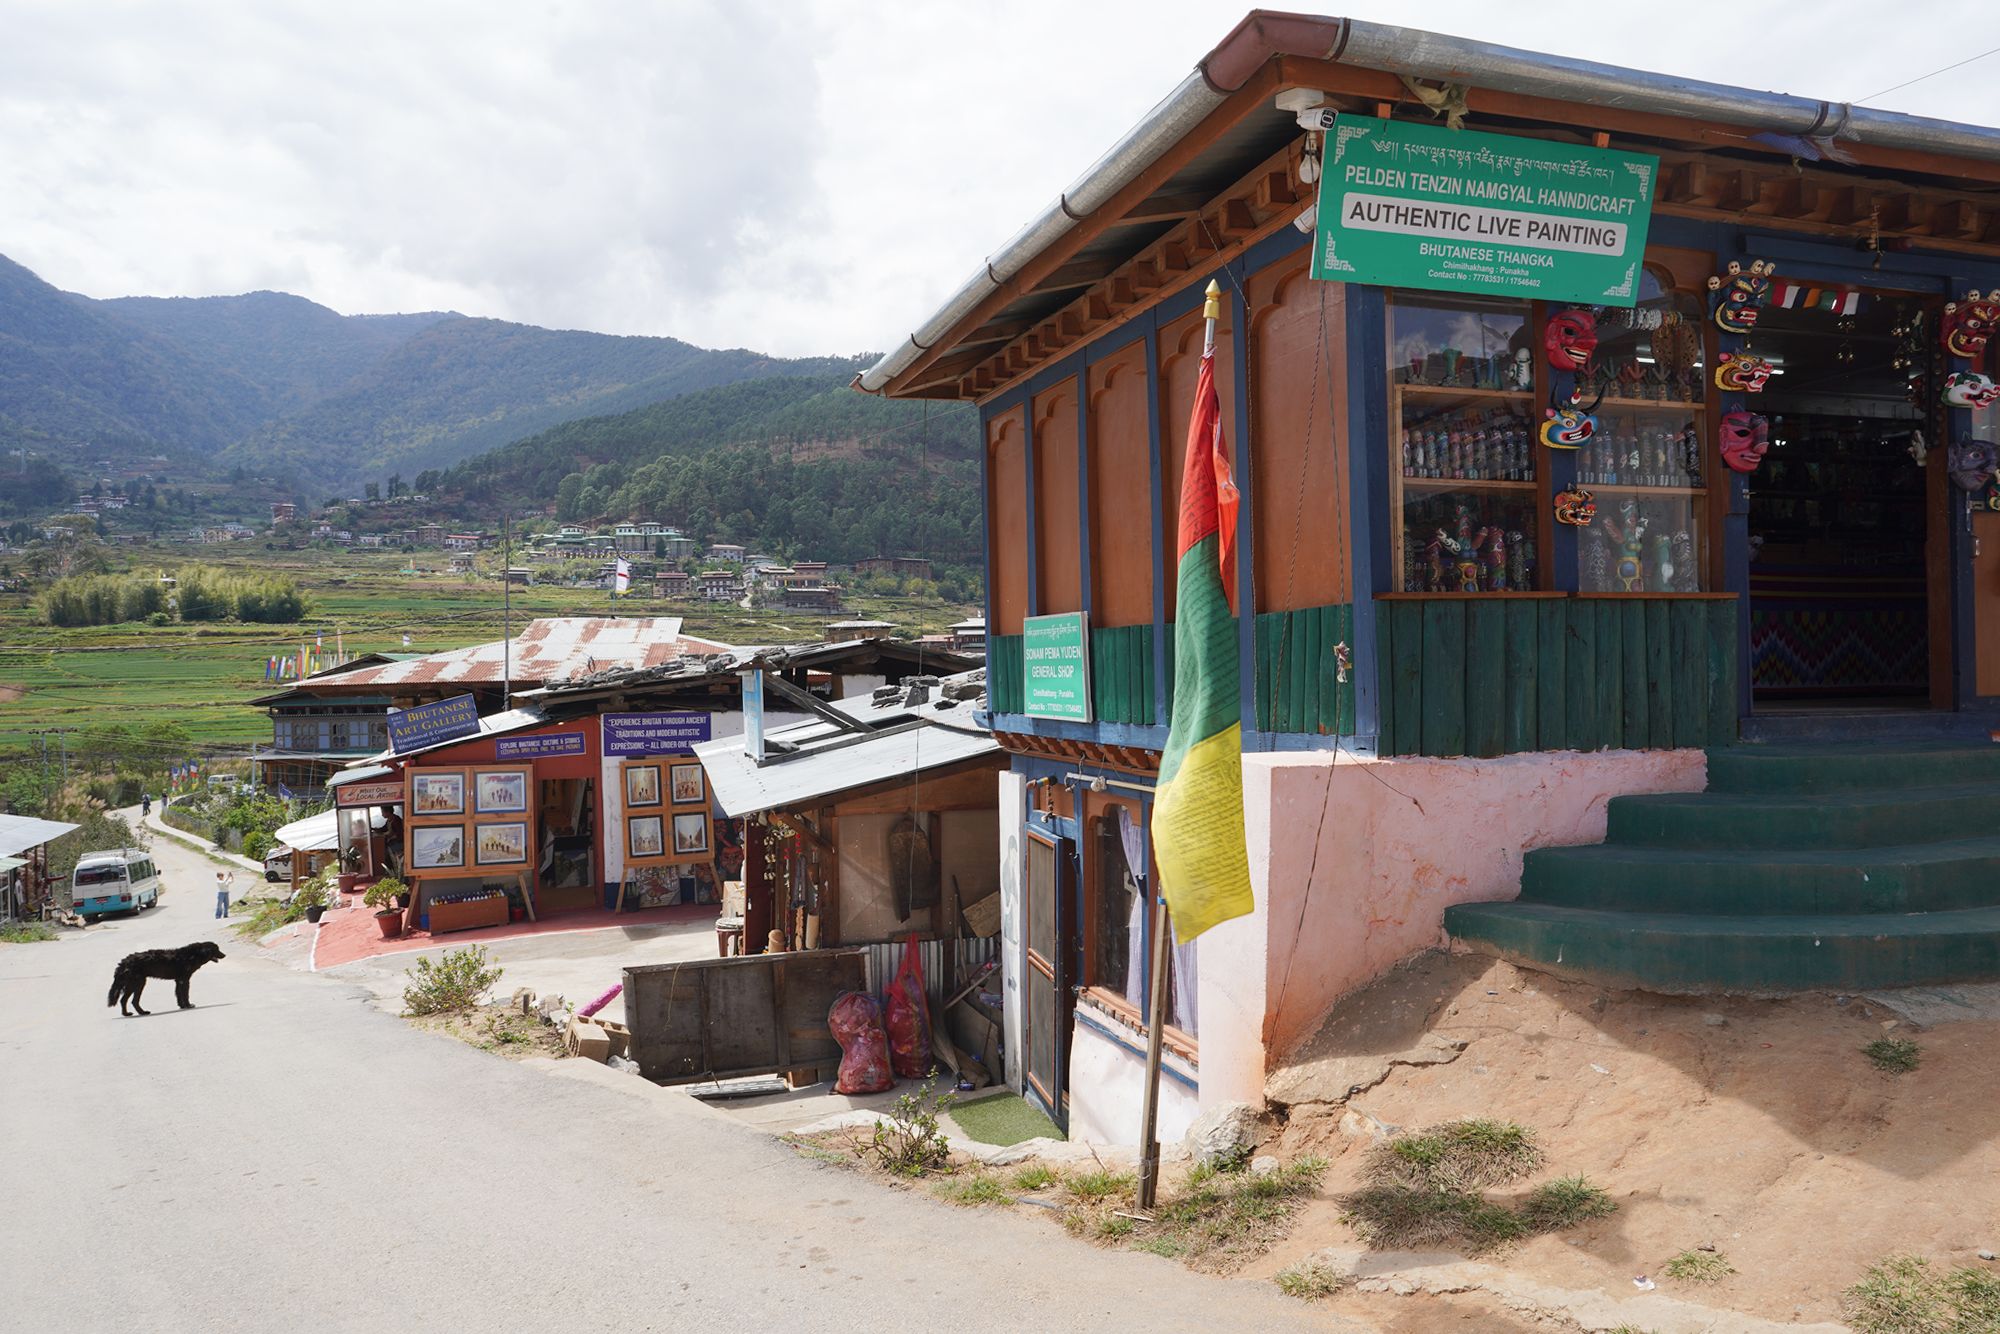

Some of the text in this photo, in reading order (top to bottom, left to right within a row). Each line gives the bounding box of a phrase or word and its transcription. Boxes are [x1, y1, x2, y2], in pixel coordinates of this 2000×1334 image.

[1345, 164, 1635, 216] PELDEN TENZIN NAMGYAL HANNDICRAFT
[1349, 201, 1616, 247] AUTHENTIC LIVE PAINTING
[1420, 242, 1554, 268] BHUTANESE THANGKA
[1428, 269, 1456, 280] Contact
[1457, 272, 1467, 280] No
[1443, 260, 1494, 275] Chimilhakhang
[1500, 266, 1529, 277] Punakha
[1026, 645, 1081, 660] SONAM PEMA YUDEN
[1031, 665, 1074, 678] GENERAL SHOP
[407, 700, 470, 722] BHUTANESE
[395, 724, 418, 737] ART
[421, 711, 473, 730] GALLERY
[642, 717, 662, 726] BHUTAN
[662, 717, 685, 725] THROUGH
[686, 716, 707, 725] ANCIENT
[397, 732, 428, 744] Traditional
[434, 722, 476, 735] Contemporary
[616, 728, 700, 738] TRADITIONS AND MODERN ARTISTIC
[398, 738, 430, 751] Bhutanese
[610, 742, 645, 751] EXPRESSIONS
[650, 741, 660, 749] ALL
[660, 741, 677, 749] UNDER
[678, 740, 688, 748] ONE
